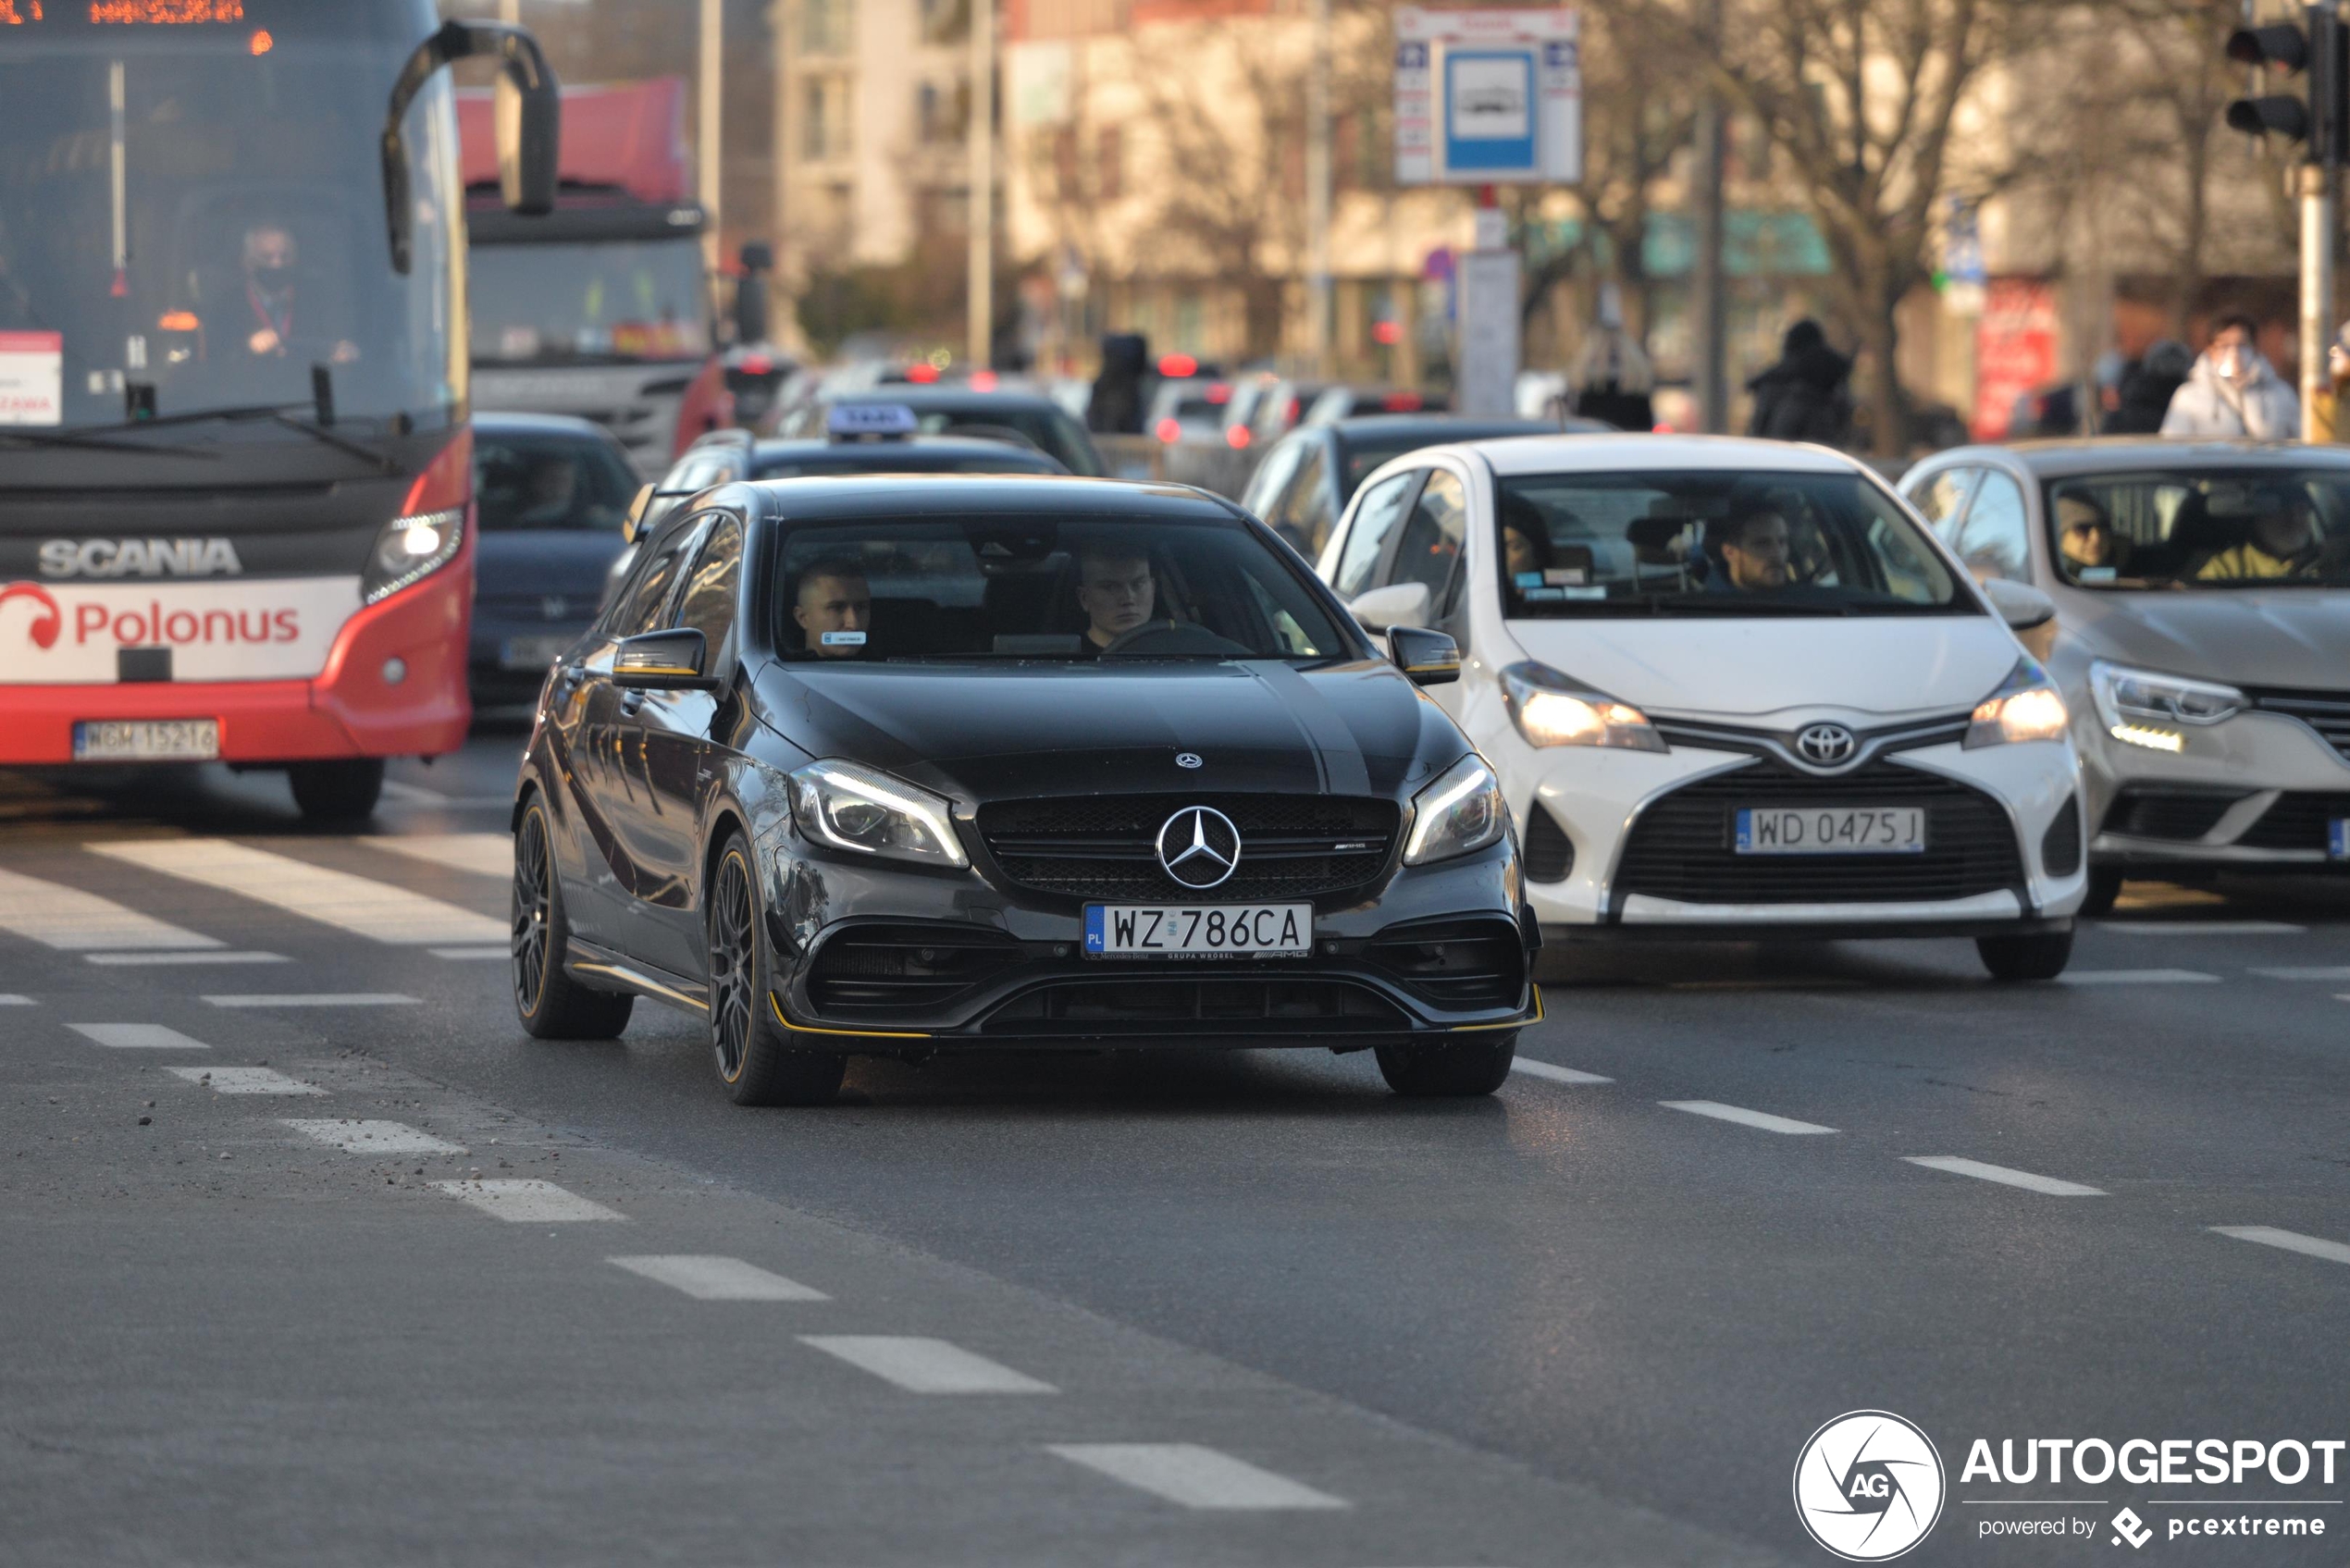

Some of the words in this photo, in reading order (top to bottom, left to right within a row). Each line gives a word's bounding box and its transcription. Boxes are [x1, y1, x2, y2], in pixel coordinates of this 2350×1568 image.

[40, 537, 242, 577] SCANIA
[76, 599, 299, 645] Polonus
[1758, 813, 1803, 845] WD
[1817, 812, 1916, 845] 0475J
[1088, 934, 1102, 945] PL
[1113, 909, 1164, 947] WZ
[1181, 908, 1300, 947] 786CA
[1100, 952, 1149, 960] Mercedes-Benz
[1270, 950, 1308, 958] AMG
